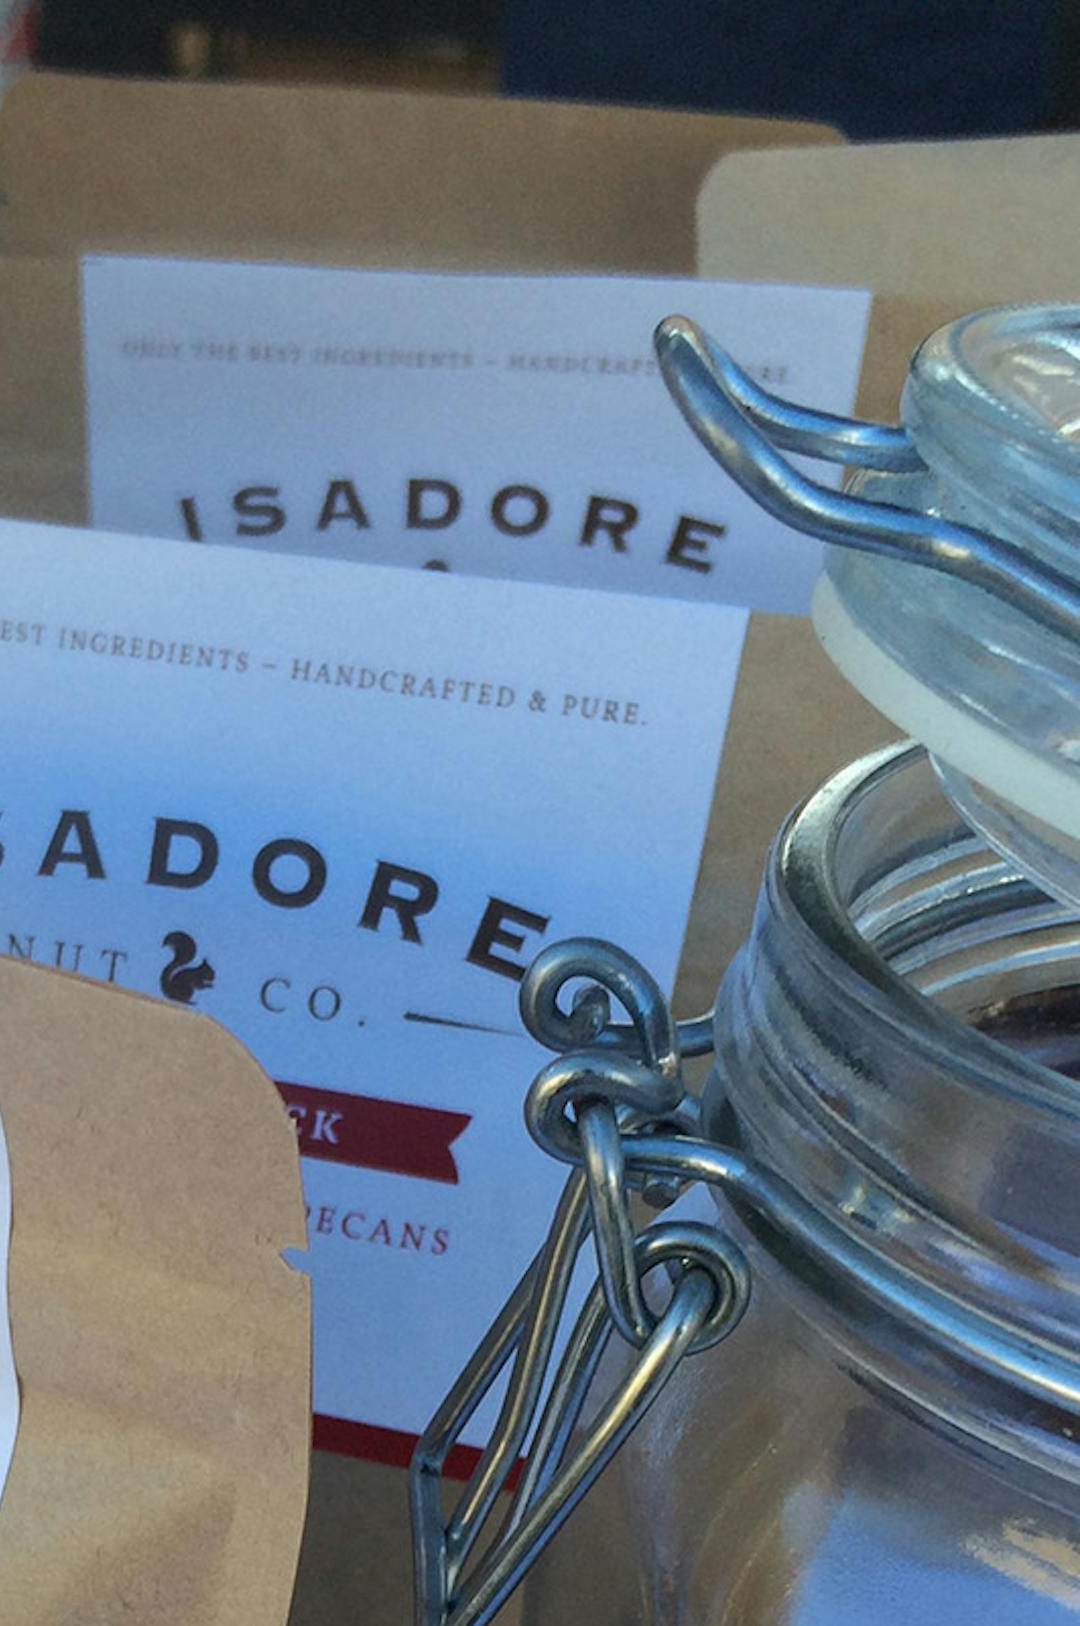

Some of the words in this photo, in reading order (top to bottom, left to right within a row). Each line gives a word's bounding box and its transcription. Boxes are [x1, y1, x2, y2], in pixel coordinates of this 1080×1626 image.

[177, 478, 726, 574] ISADORE
[58, 626, 251, 673] INGREDIENTS
[290, 658, 517, 709] HANDCRAFTED
[527, 689, 548, 713] &
[561, 692, 649, 727] PURE.
[259, 976, 366, 1028] CO.
[305, 1205, 450, 1255] ECANS
